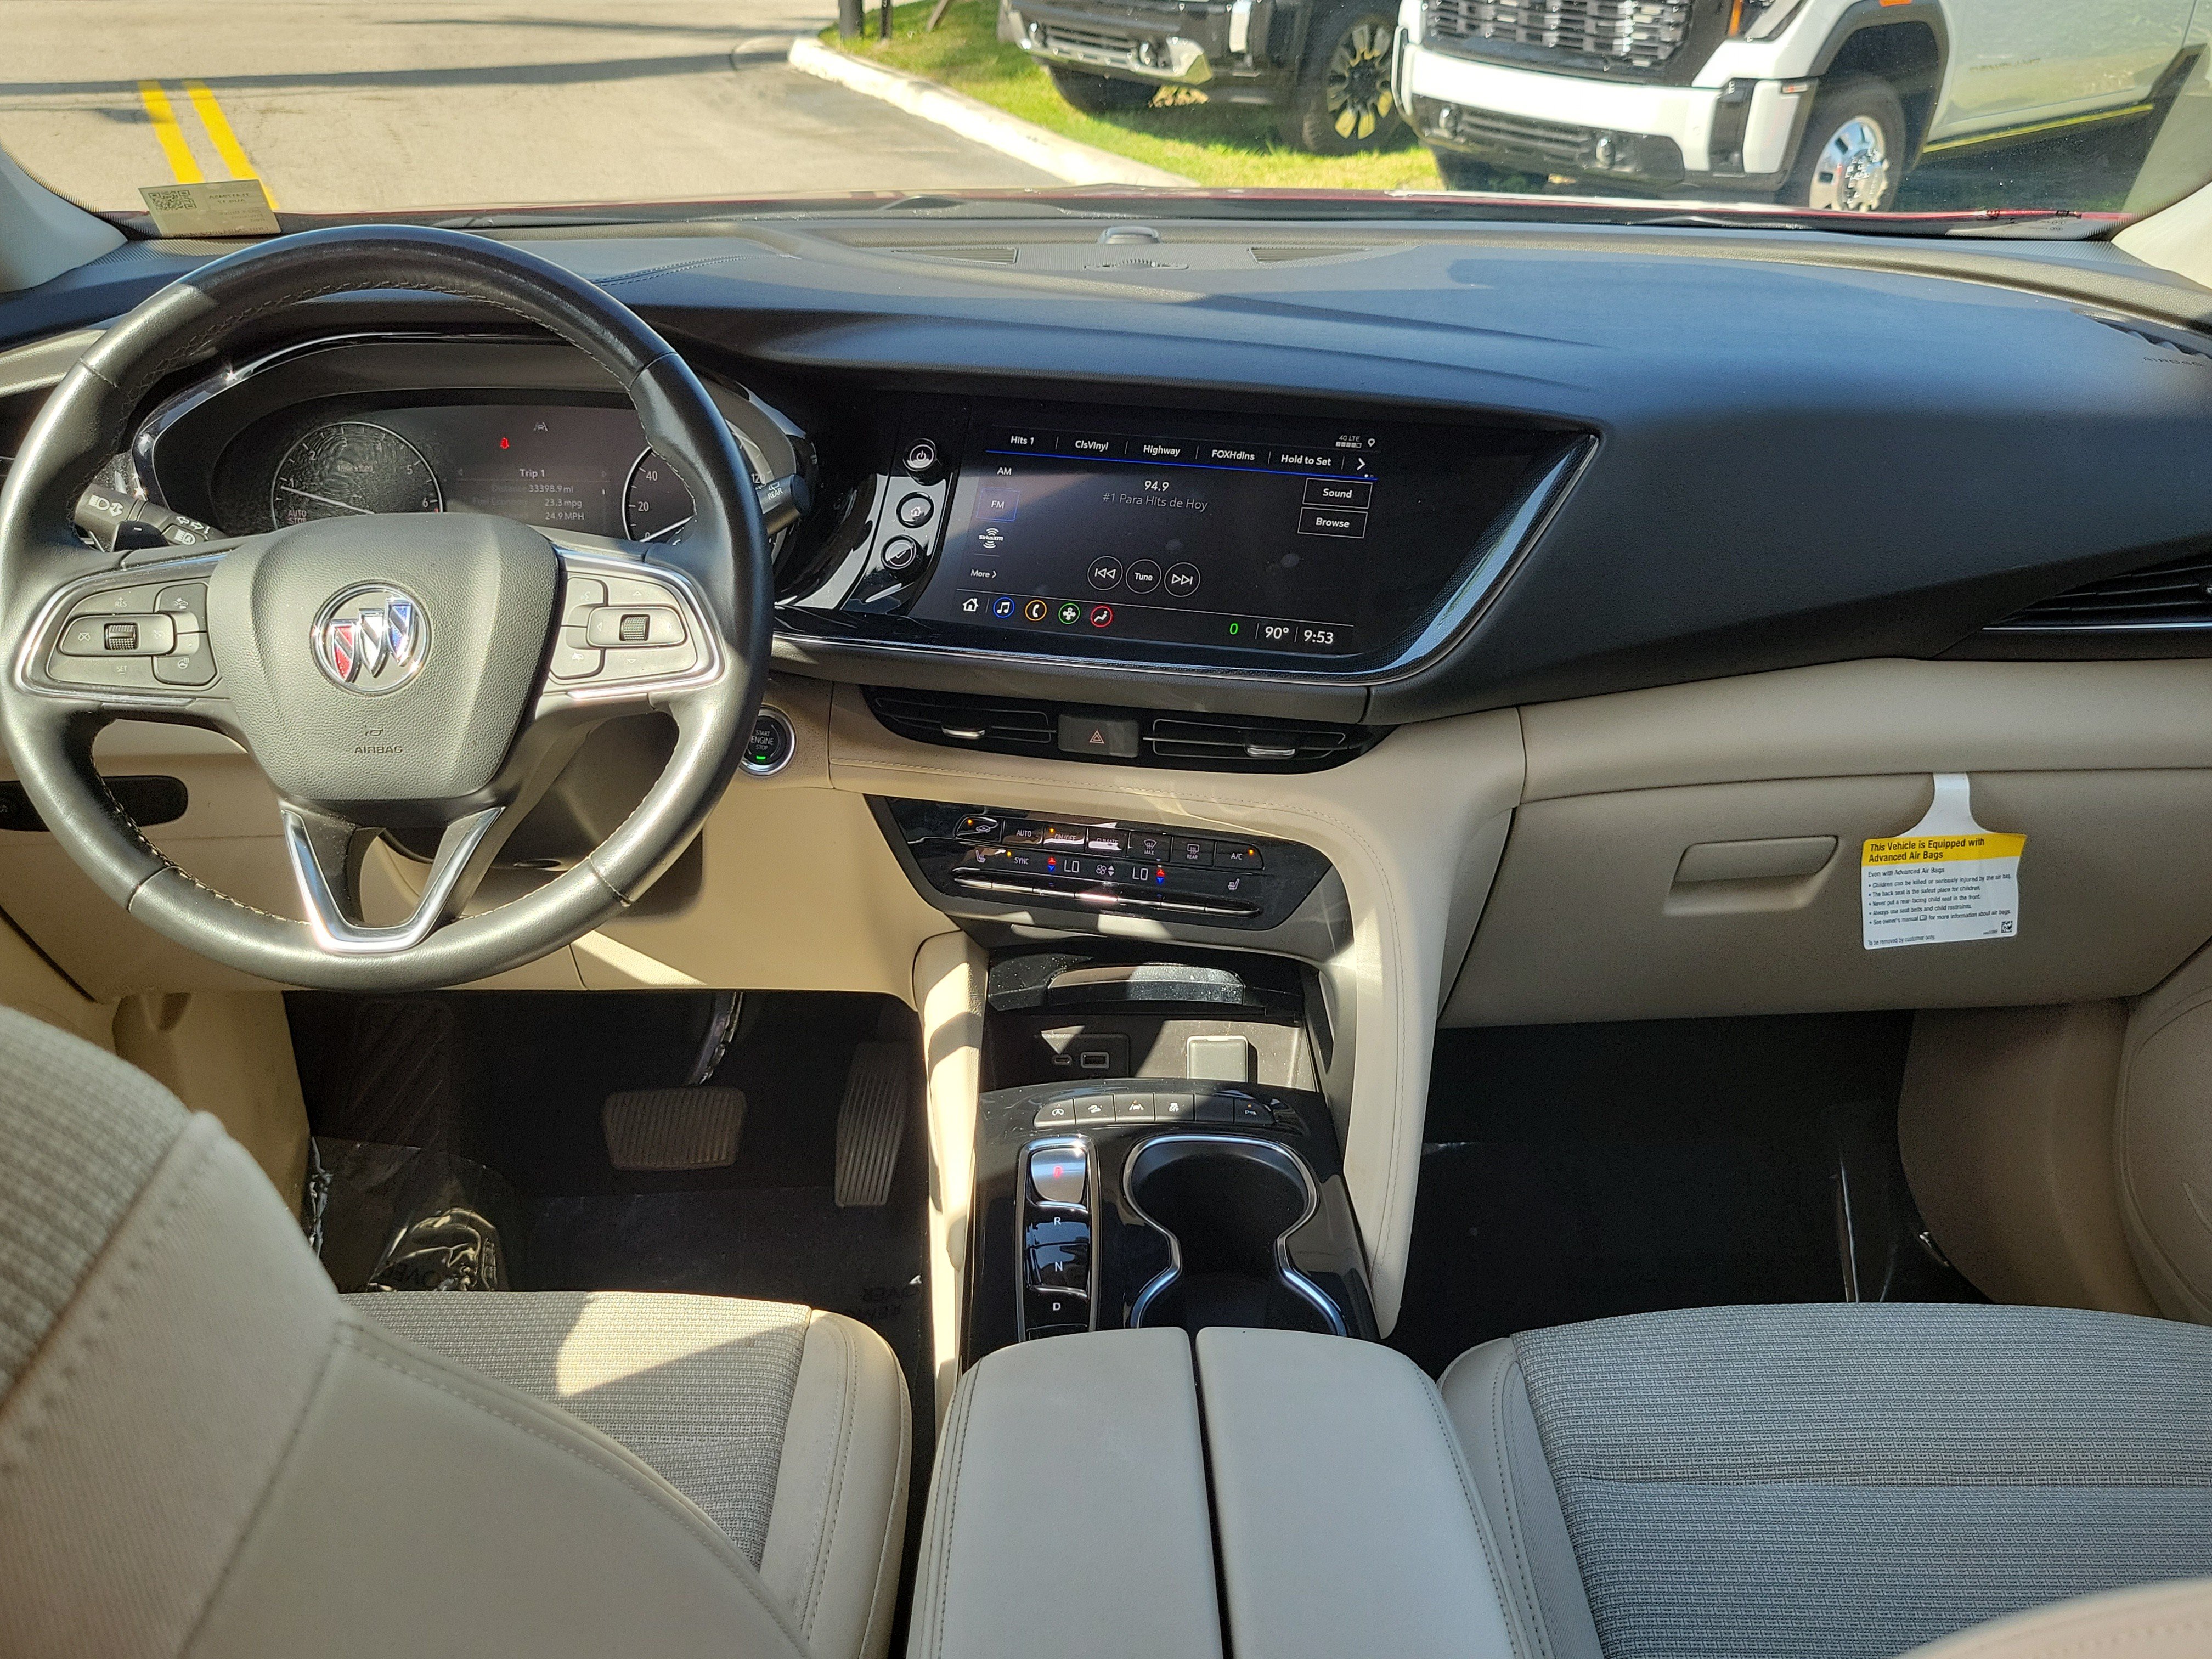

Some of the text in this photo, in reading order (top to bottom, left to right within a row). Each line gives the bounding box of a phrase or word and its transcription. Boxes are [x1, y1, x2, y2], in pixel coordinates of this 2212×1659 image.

[1011, 436, 1034, 445] Hits 1
[1075, 440, 1109, 452] ClsVinyl
[308, 451, 316, 461] 2
[1143, 445, 1180, 457] Highway
[1281, 454, 1332, 466] Hold to Set
[406, 464, 413, 475] 5
[520, 468, 545, 479] Trip 1
[997, 467, 1012, 476] AM
[646, 471, 658, 481] 40
[751, 473, 765, 484] 120
[289, 478, 295, 487] 1
[1144, 481, 1169, 492] 94.9
[767, 487, 783, 500] REAR
[1322, 488, 1353, 498] Sound
[422, 497, 428, 507] 6
[638, 501, 649, 511] 20
[991, 500, 1005, 509] FM
[1102, 493, 1208, 512] #1 Para Hits de Hoy
[1316, 517, 1350, 528] Browse
[970, 569, 990, 578] More
[1135, 572, 1153, 582] Tune
[1265, 626, 1289, 639] 90°
[1304, 630, 1334, 644] 9:53
[751, 736, 774, 746] ENGINE
[354, 746, 403, 754] AIRBAG
[1870, 838, 1985, 852] This Vehicle is Equipped with
[1869, 851, 1943, 862] Advanced Air Bags
[1064, 859, 1080, 873] LO
[1132, 867, 1148, 881] LO
[1053, 1166, 1062, 1178] P
[1053, 1217, 1062, 1226] R
[1054, 1261, 1063, 1272] N
[1052, 1302, 1061, 1311] D
